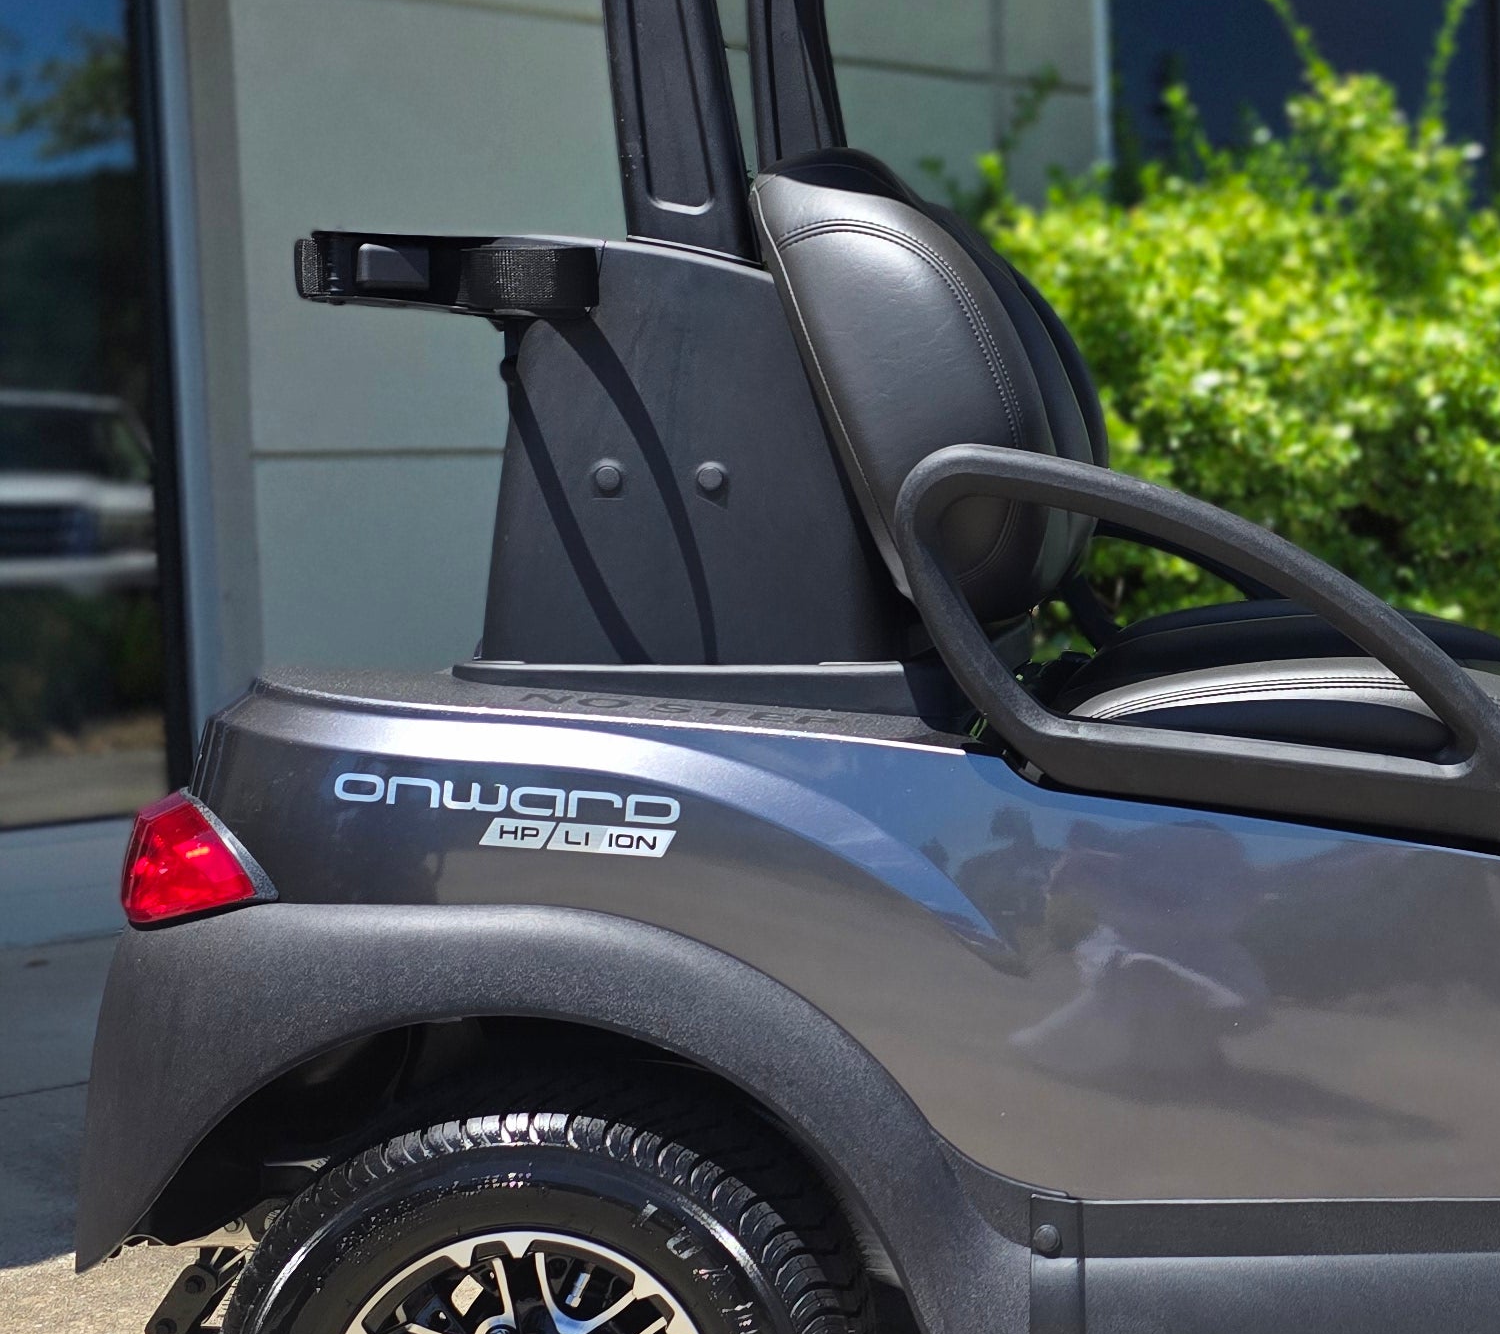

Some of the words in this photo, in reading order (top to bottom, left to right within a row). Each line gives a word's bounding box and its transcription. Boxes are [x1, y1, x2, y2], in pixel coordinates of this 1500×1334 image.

[518, 692, 633, 709] NO
[648, 701, 844, 724] STEP
[499, 824, 541, 841] HP
[564, 829, 591, 847] LI
[607, 831, 658, 851] ION
